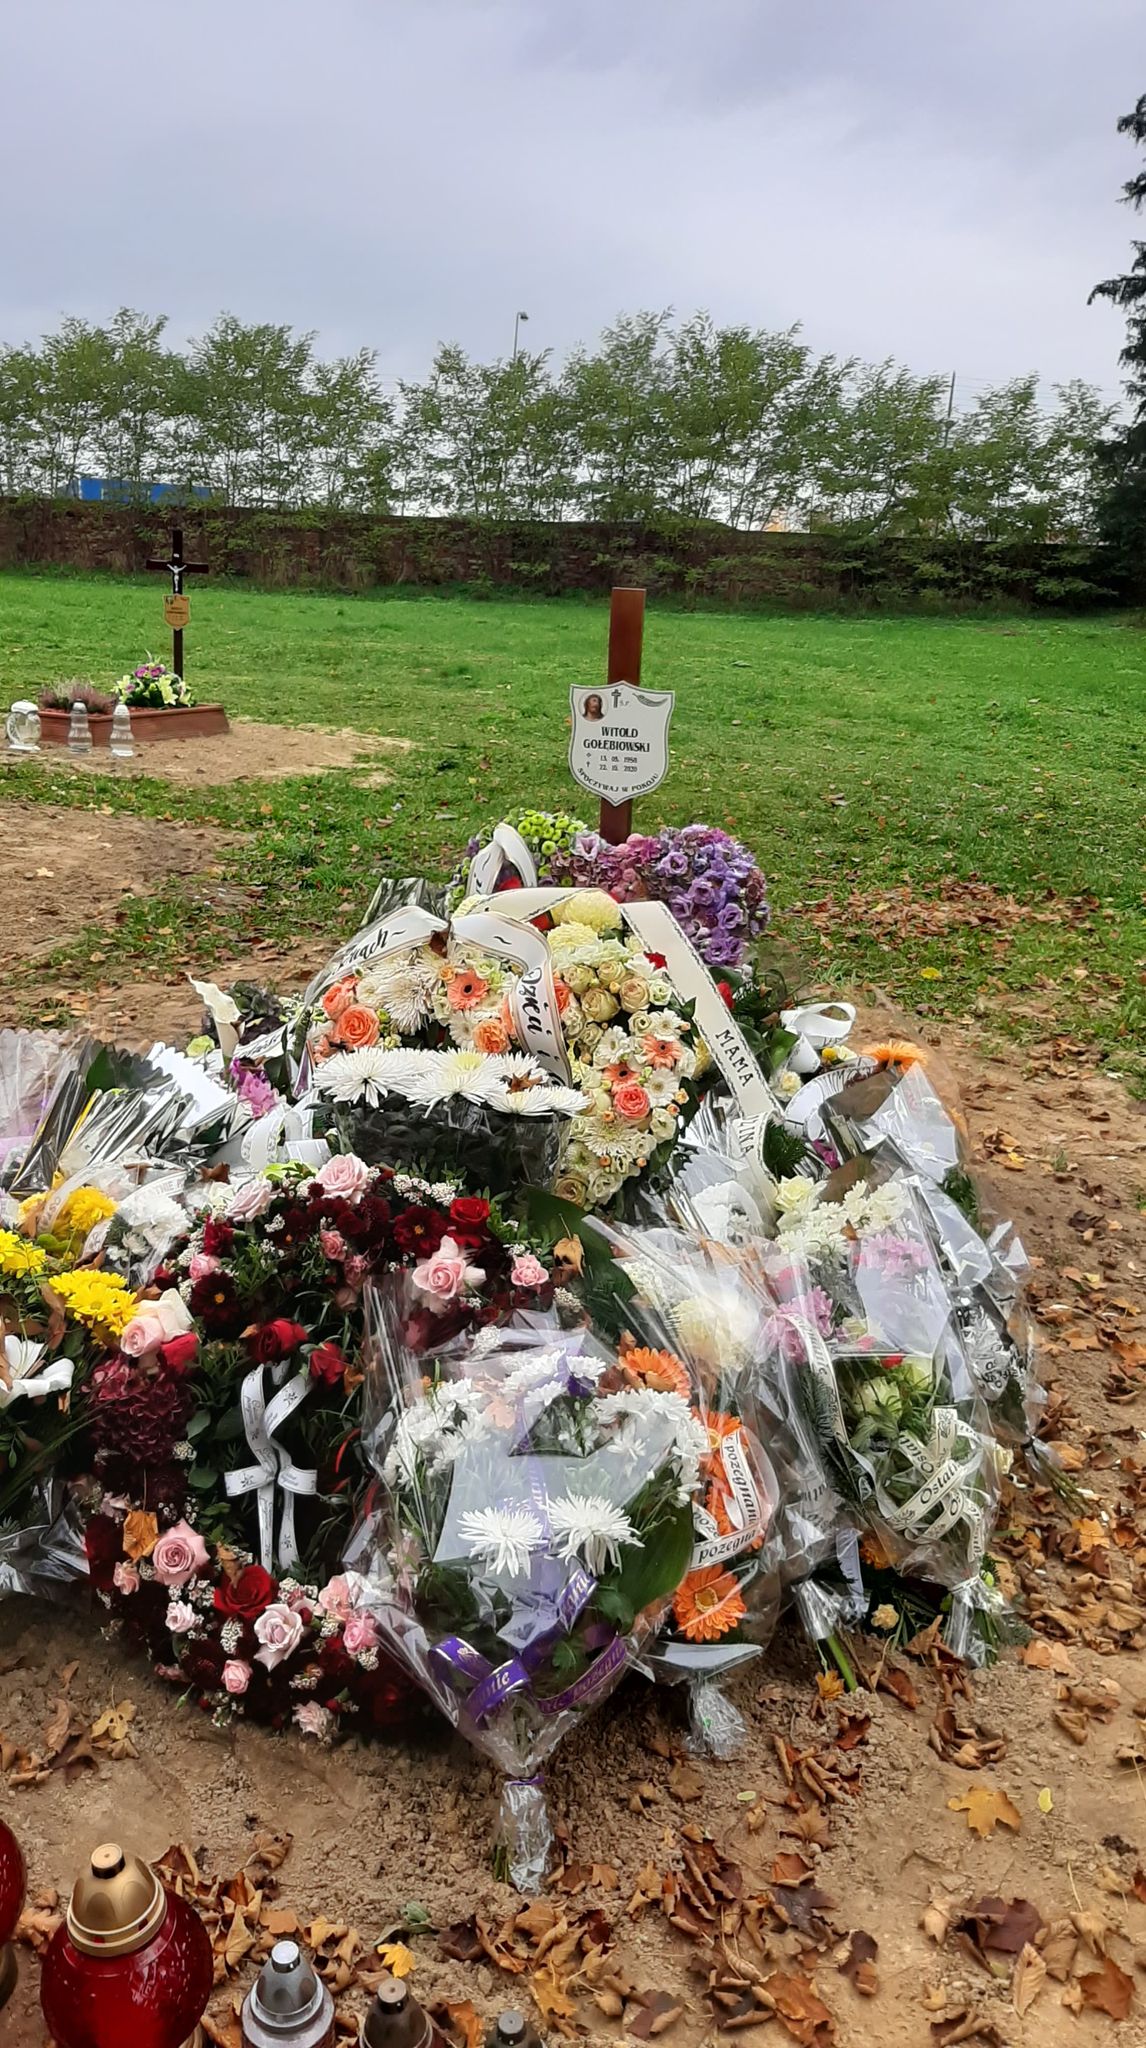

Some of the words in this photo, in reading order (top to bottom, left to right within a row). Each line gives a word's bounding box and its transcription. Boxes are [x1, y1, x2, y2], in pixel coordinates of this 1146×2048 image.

[602, 727, 638, 738] WITOLD
[577, 767, 619, 792] SPOCZYWAJ
[631, 773, 659, 792] POKOJU
[715, 1029, 754, 1087] MAMA
